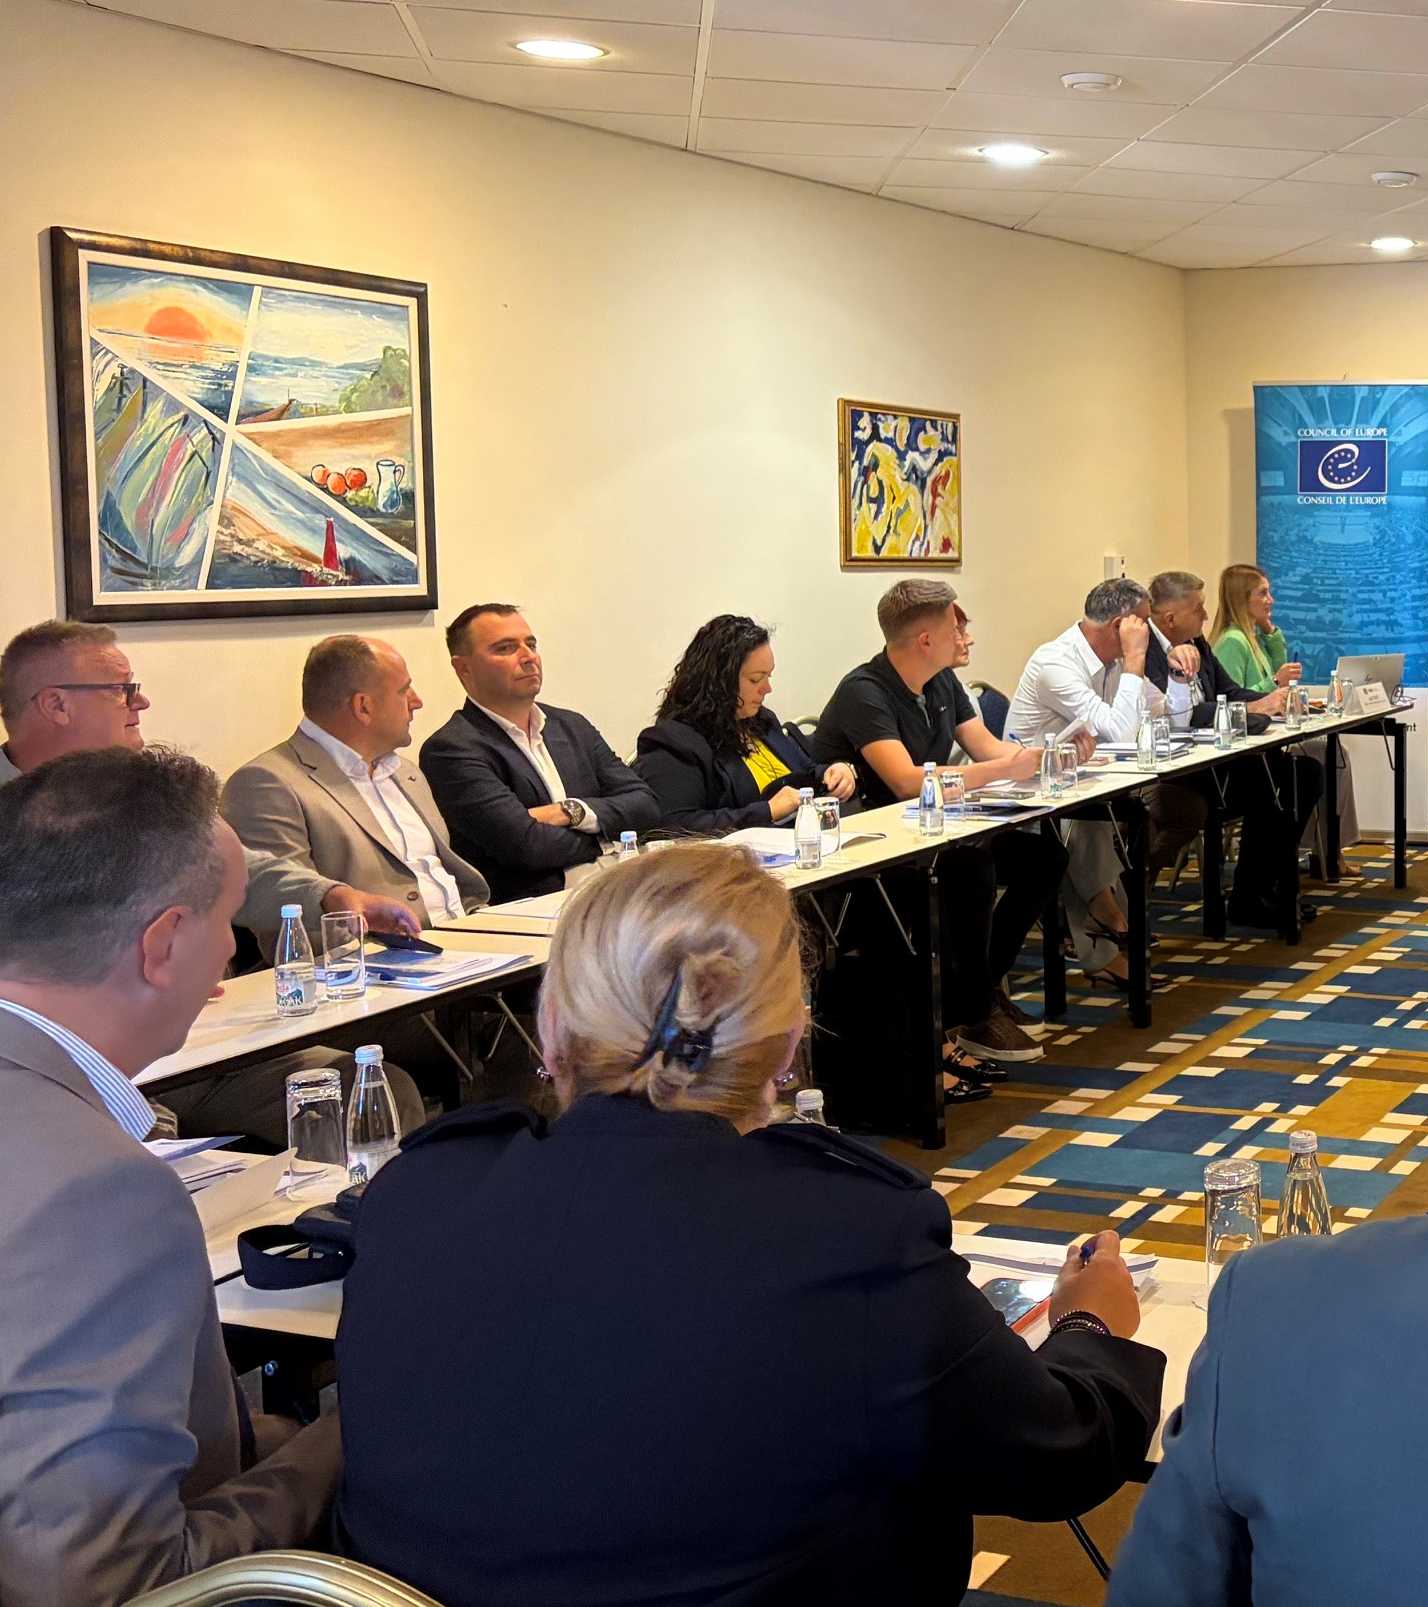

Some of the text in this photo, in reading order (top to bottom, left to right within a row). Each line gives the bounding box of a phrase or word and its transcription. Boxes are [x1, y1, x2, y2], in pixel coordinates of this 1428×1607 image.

[1297, 428, 1387, 437] COUNCIL OF EUROPE
[1297, 495, 1334, 505] CONSEIL
[1336, 496, 1346, 504] DE
